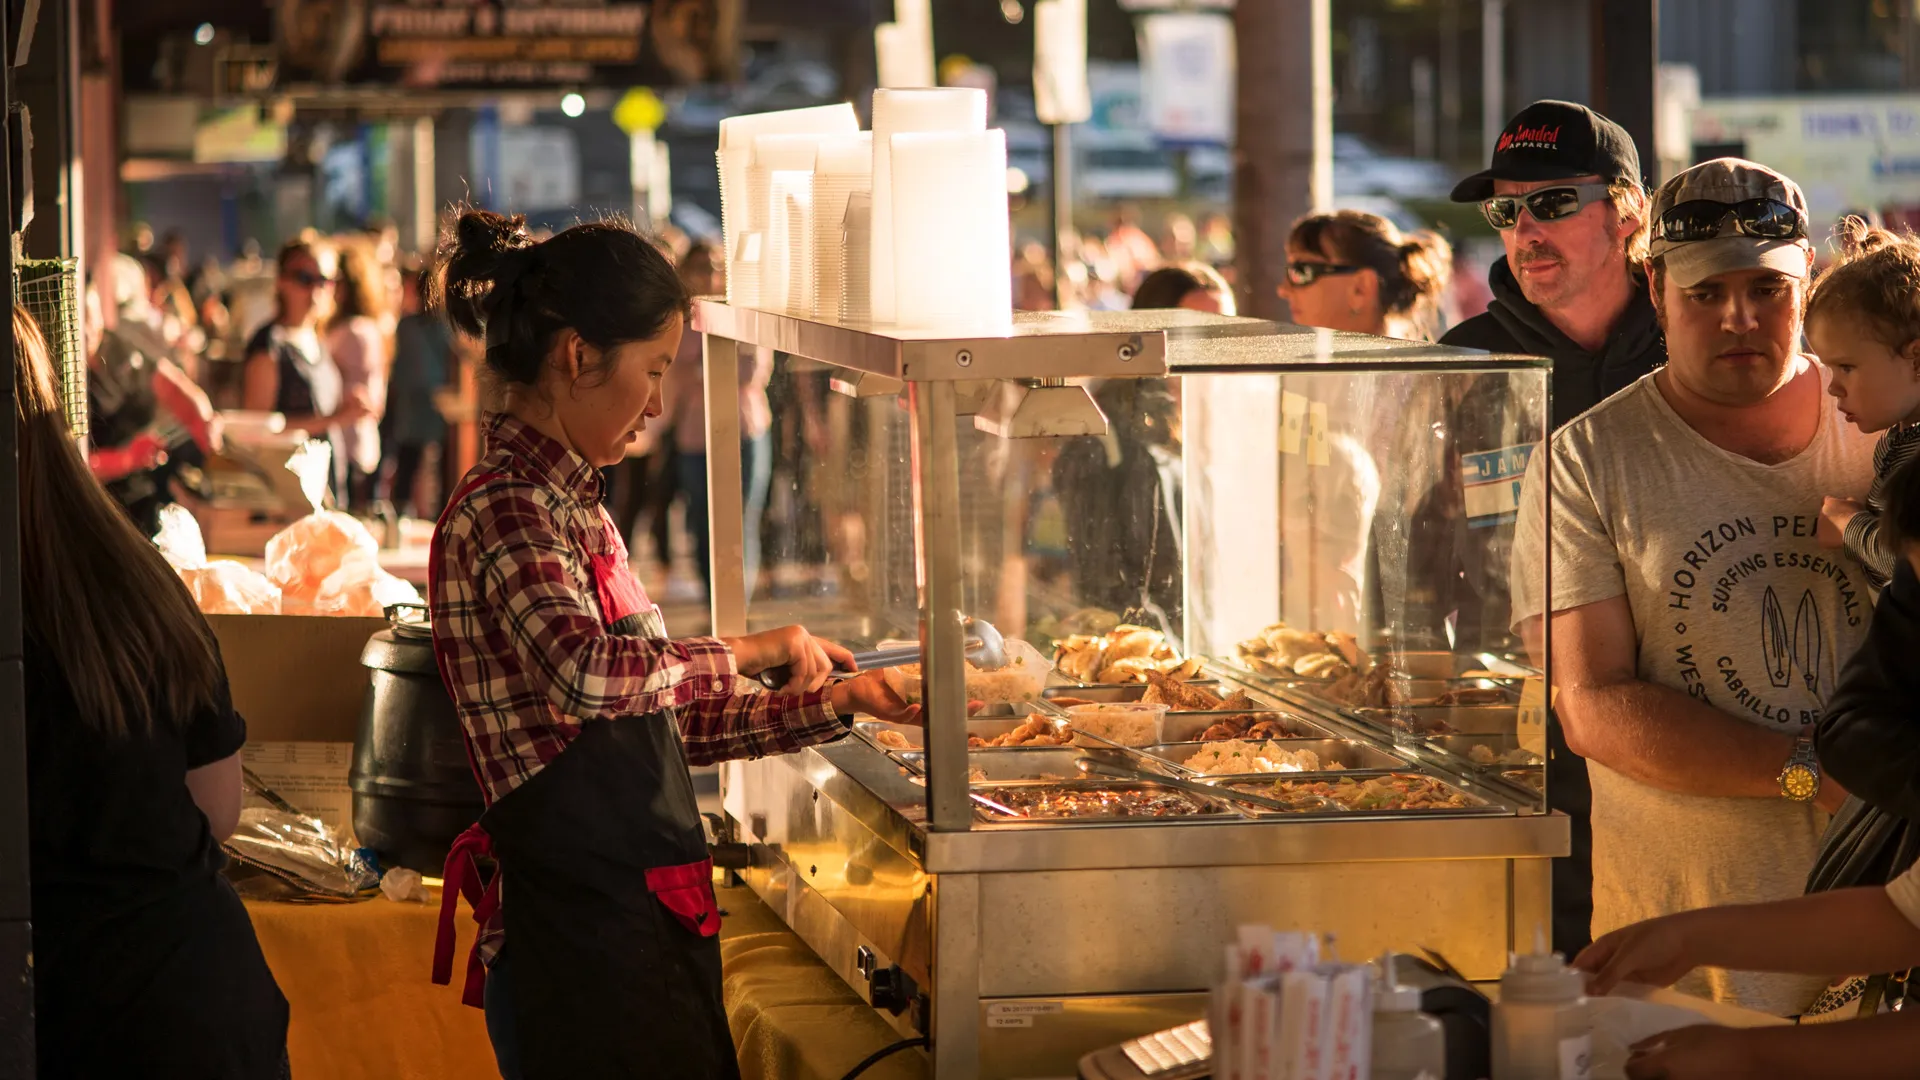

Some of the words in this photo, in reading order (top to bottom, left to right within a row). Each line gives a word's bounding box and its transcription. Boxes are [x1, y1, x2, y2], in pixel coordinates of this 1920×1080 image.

[1508, 142, 1558, 150] APPAREL
[1669, 516, 1757, 610] HORIZON
[1712, 553, 1767, 613] SURFING
[1774, 552, 1861, 628] ESSENTIALS
[1716, 656, 1790, 724] CABRILLO
